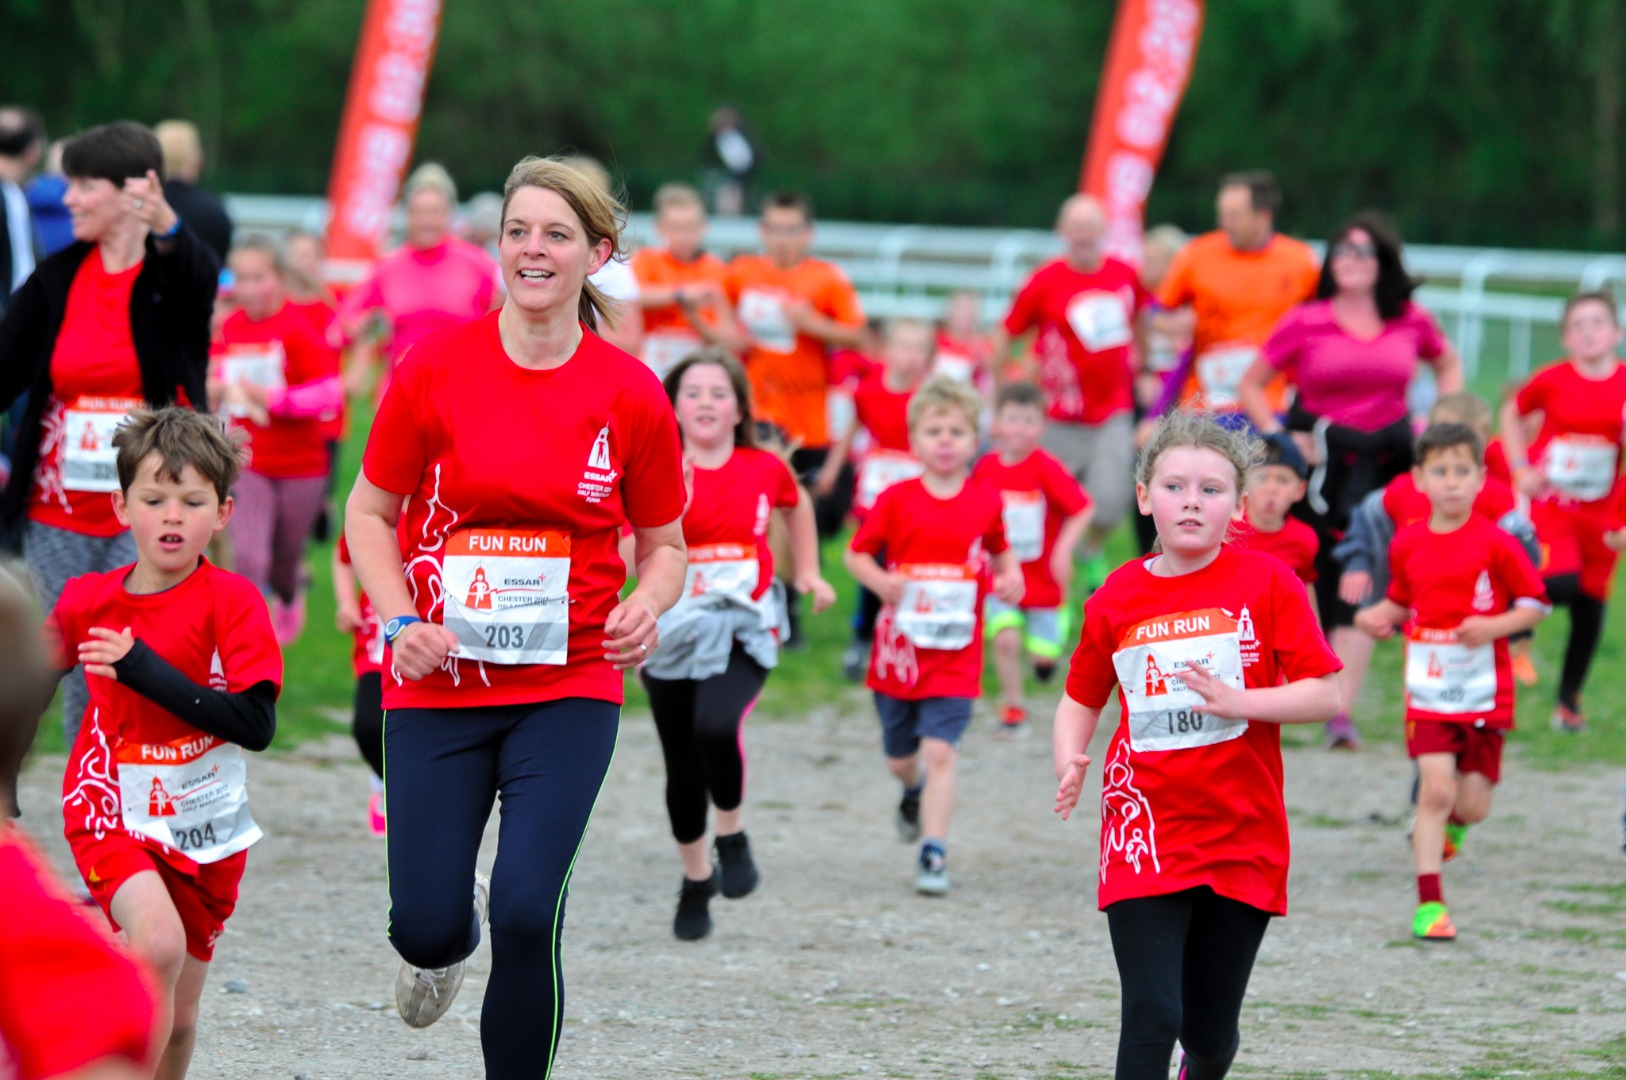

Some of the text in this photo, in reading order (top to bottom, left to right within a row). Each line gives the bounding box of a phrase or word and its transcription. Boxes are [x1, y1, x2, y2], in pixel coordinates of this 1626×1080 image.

[578, 482, 604, 491] CHESTER
[584, 472, 612, 483] ESSAR
[469, 535, 547, 552] FUN RUN
[485, 625, 524, 649] 203
[1136, 616, 1210, 640] FUN RUN
[1174, 658, 1209, 669] ESAR
[1168, 710, 1203, 735] 180
[141, 735, 214, 760] FUN RUN
[182, 772, 215, 790] ESSAR
[181, 784, 228, 807] CHESTER 2017
[182, 792, 231, 814] HALF MARATHON
[175, 821, 217, 850] 204
